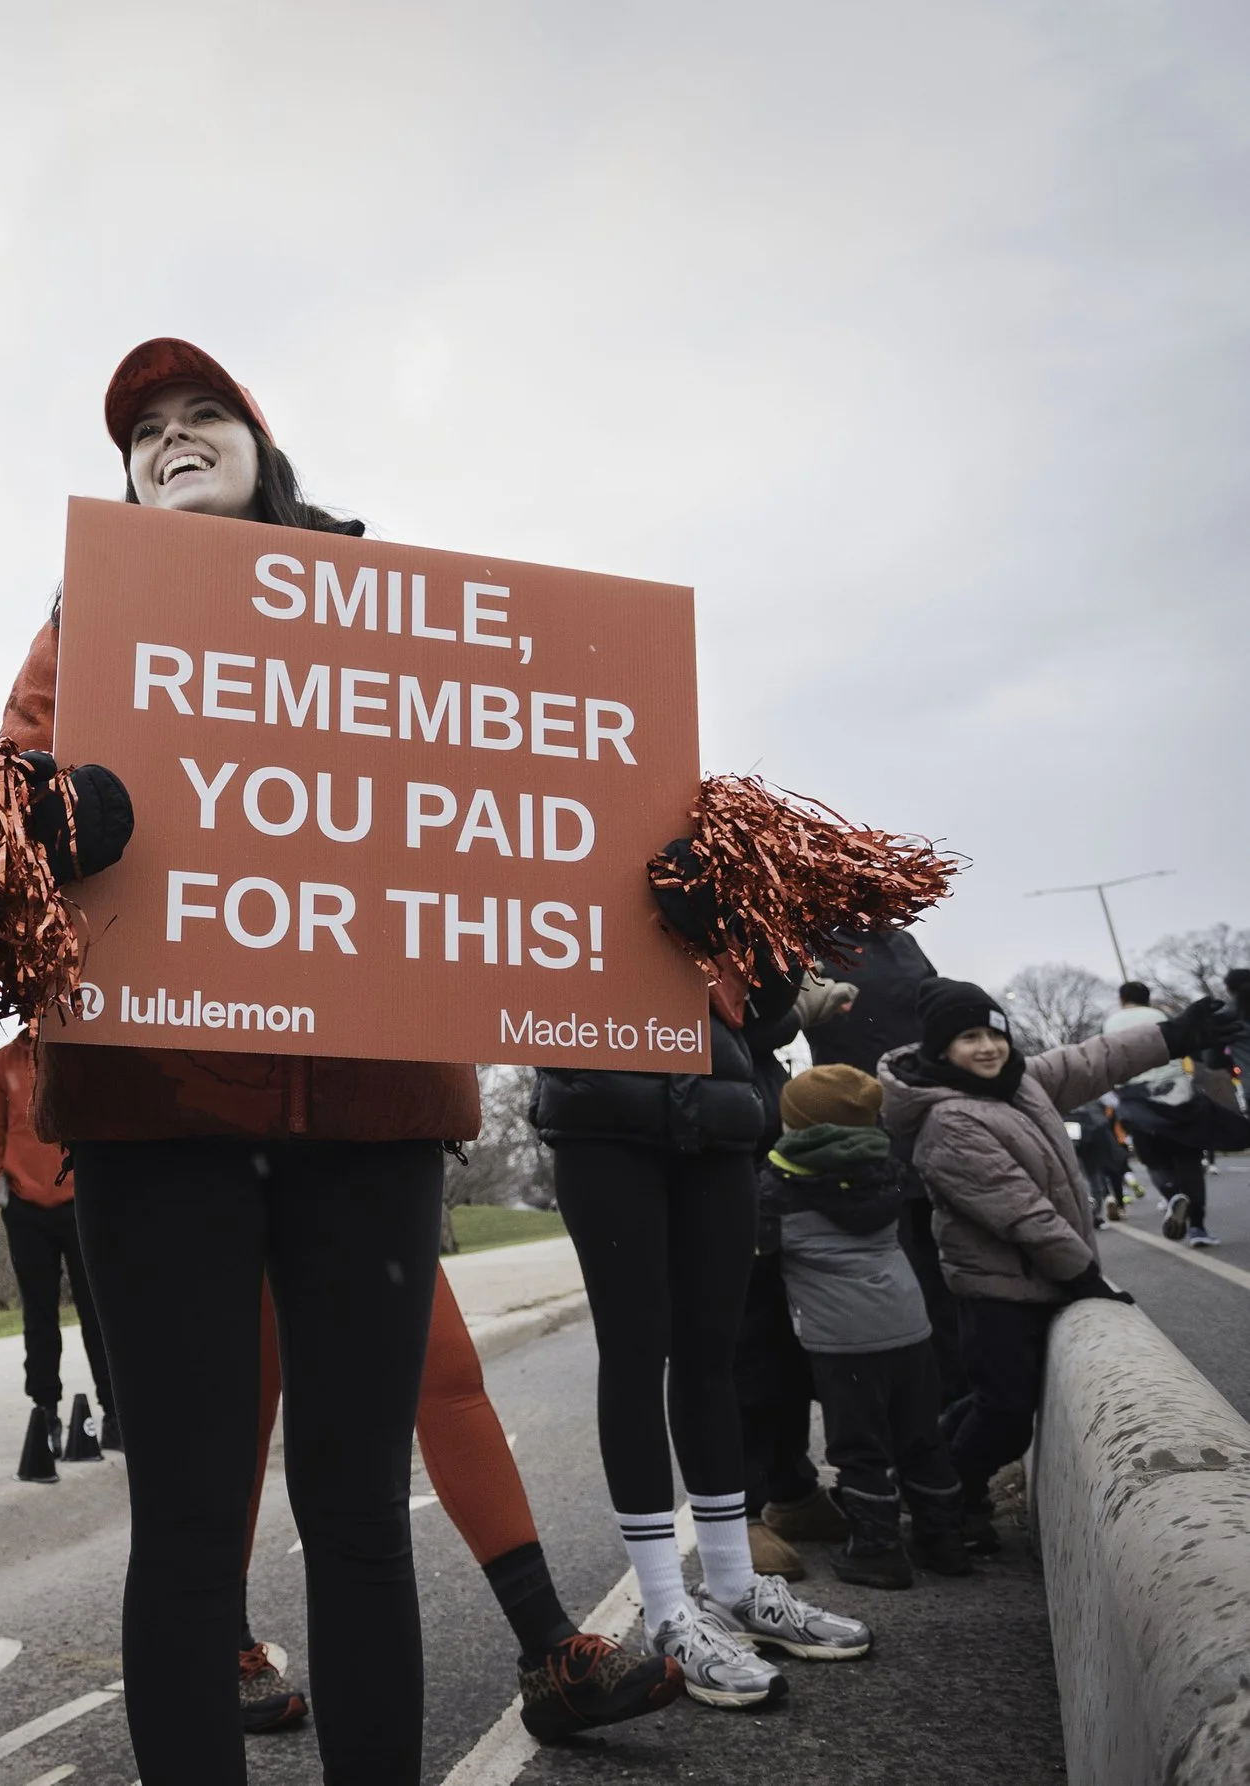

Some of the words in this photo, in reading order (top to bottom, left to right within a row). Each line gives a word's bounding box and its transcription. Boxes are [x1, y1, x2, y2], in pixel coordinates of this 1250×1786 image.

[250, 553, 534, 665] SMILE,
[132, 642, 638, 766] REMEMBER
[179, 757, 374, 843] YOU
[405, 781, 596, 862] PAID
[165, 870, 360, 955] FOR
[385, 888, 605, 972] THIS!
[120, 985, 316, 1033] lululemon
[500, 1008, 599, 1049] Made
[604, 1016, 639, 1050] to
[644, 1017, 703, 1053] feel
